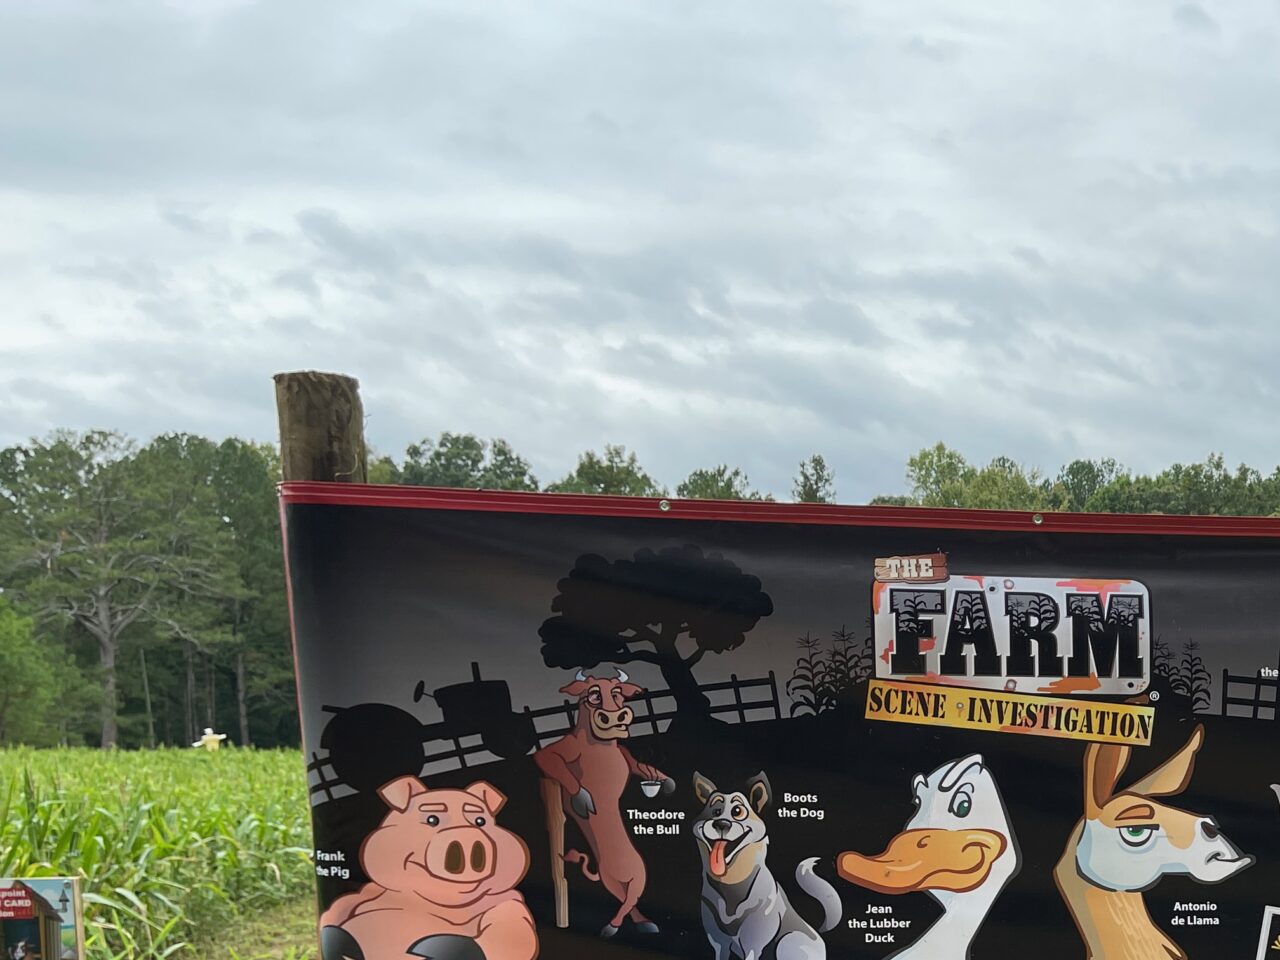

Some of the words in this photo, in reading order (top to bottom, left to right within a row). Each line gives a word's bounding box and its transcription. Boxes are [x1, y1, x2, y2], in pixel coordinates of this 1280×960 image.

[886, 558, 933, 578] THE
[889, 588, 1145, 677] FARM
[1261, 667, 1279, 677] the
[869, 687, 947, 718] SCENE
[967, 697, 1152, 740] INVESTIGATION
[784, 793, 818, 803] Boots
[627, 809, 685, 820] Theodore
[778, 807, 798, 818] the
[800, 808, 824, 820] Dog
[634, 825, 655, 835] the
[657, 824, 680, 835] Bull
[316, 850, 345, 861] Frank
[316, 865, 329, 876] the
[331, 866, 349, 879] Pig
[0, 889, 26, 898] point
[4, 899, 31, 907] CARD
[1173, 901, 1217, 911] Antonio
[865, 904, 892, 914] Jean
[848, 918, 867, 928] the
[870, 918, 911, 928] Lubber
[1171, 915, 1185, 925] de
[1187, 915, 1219, 925] Llama
[865, 933, 895, 943] Duck
